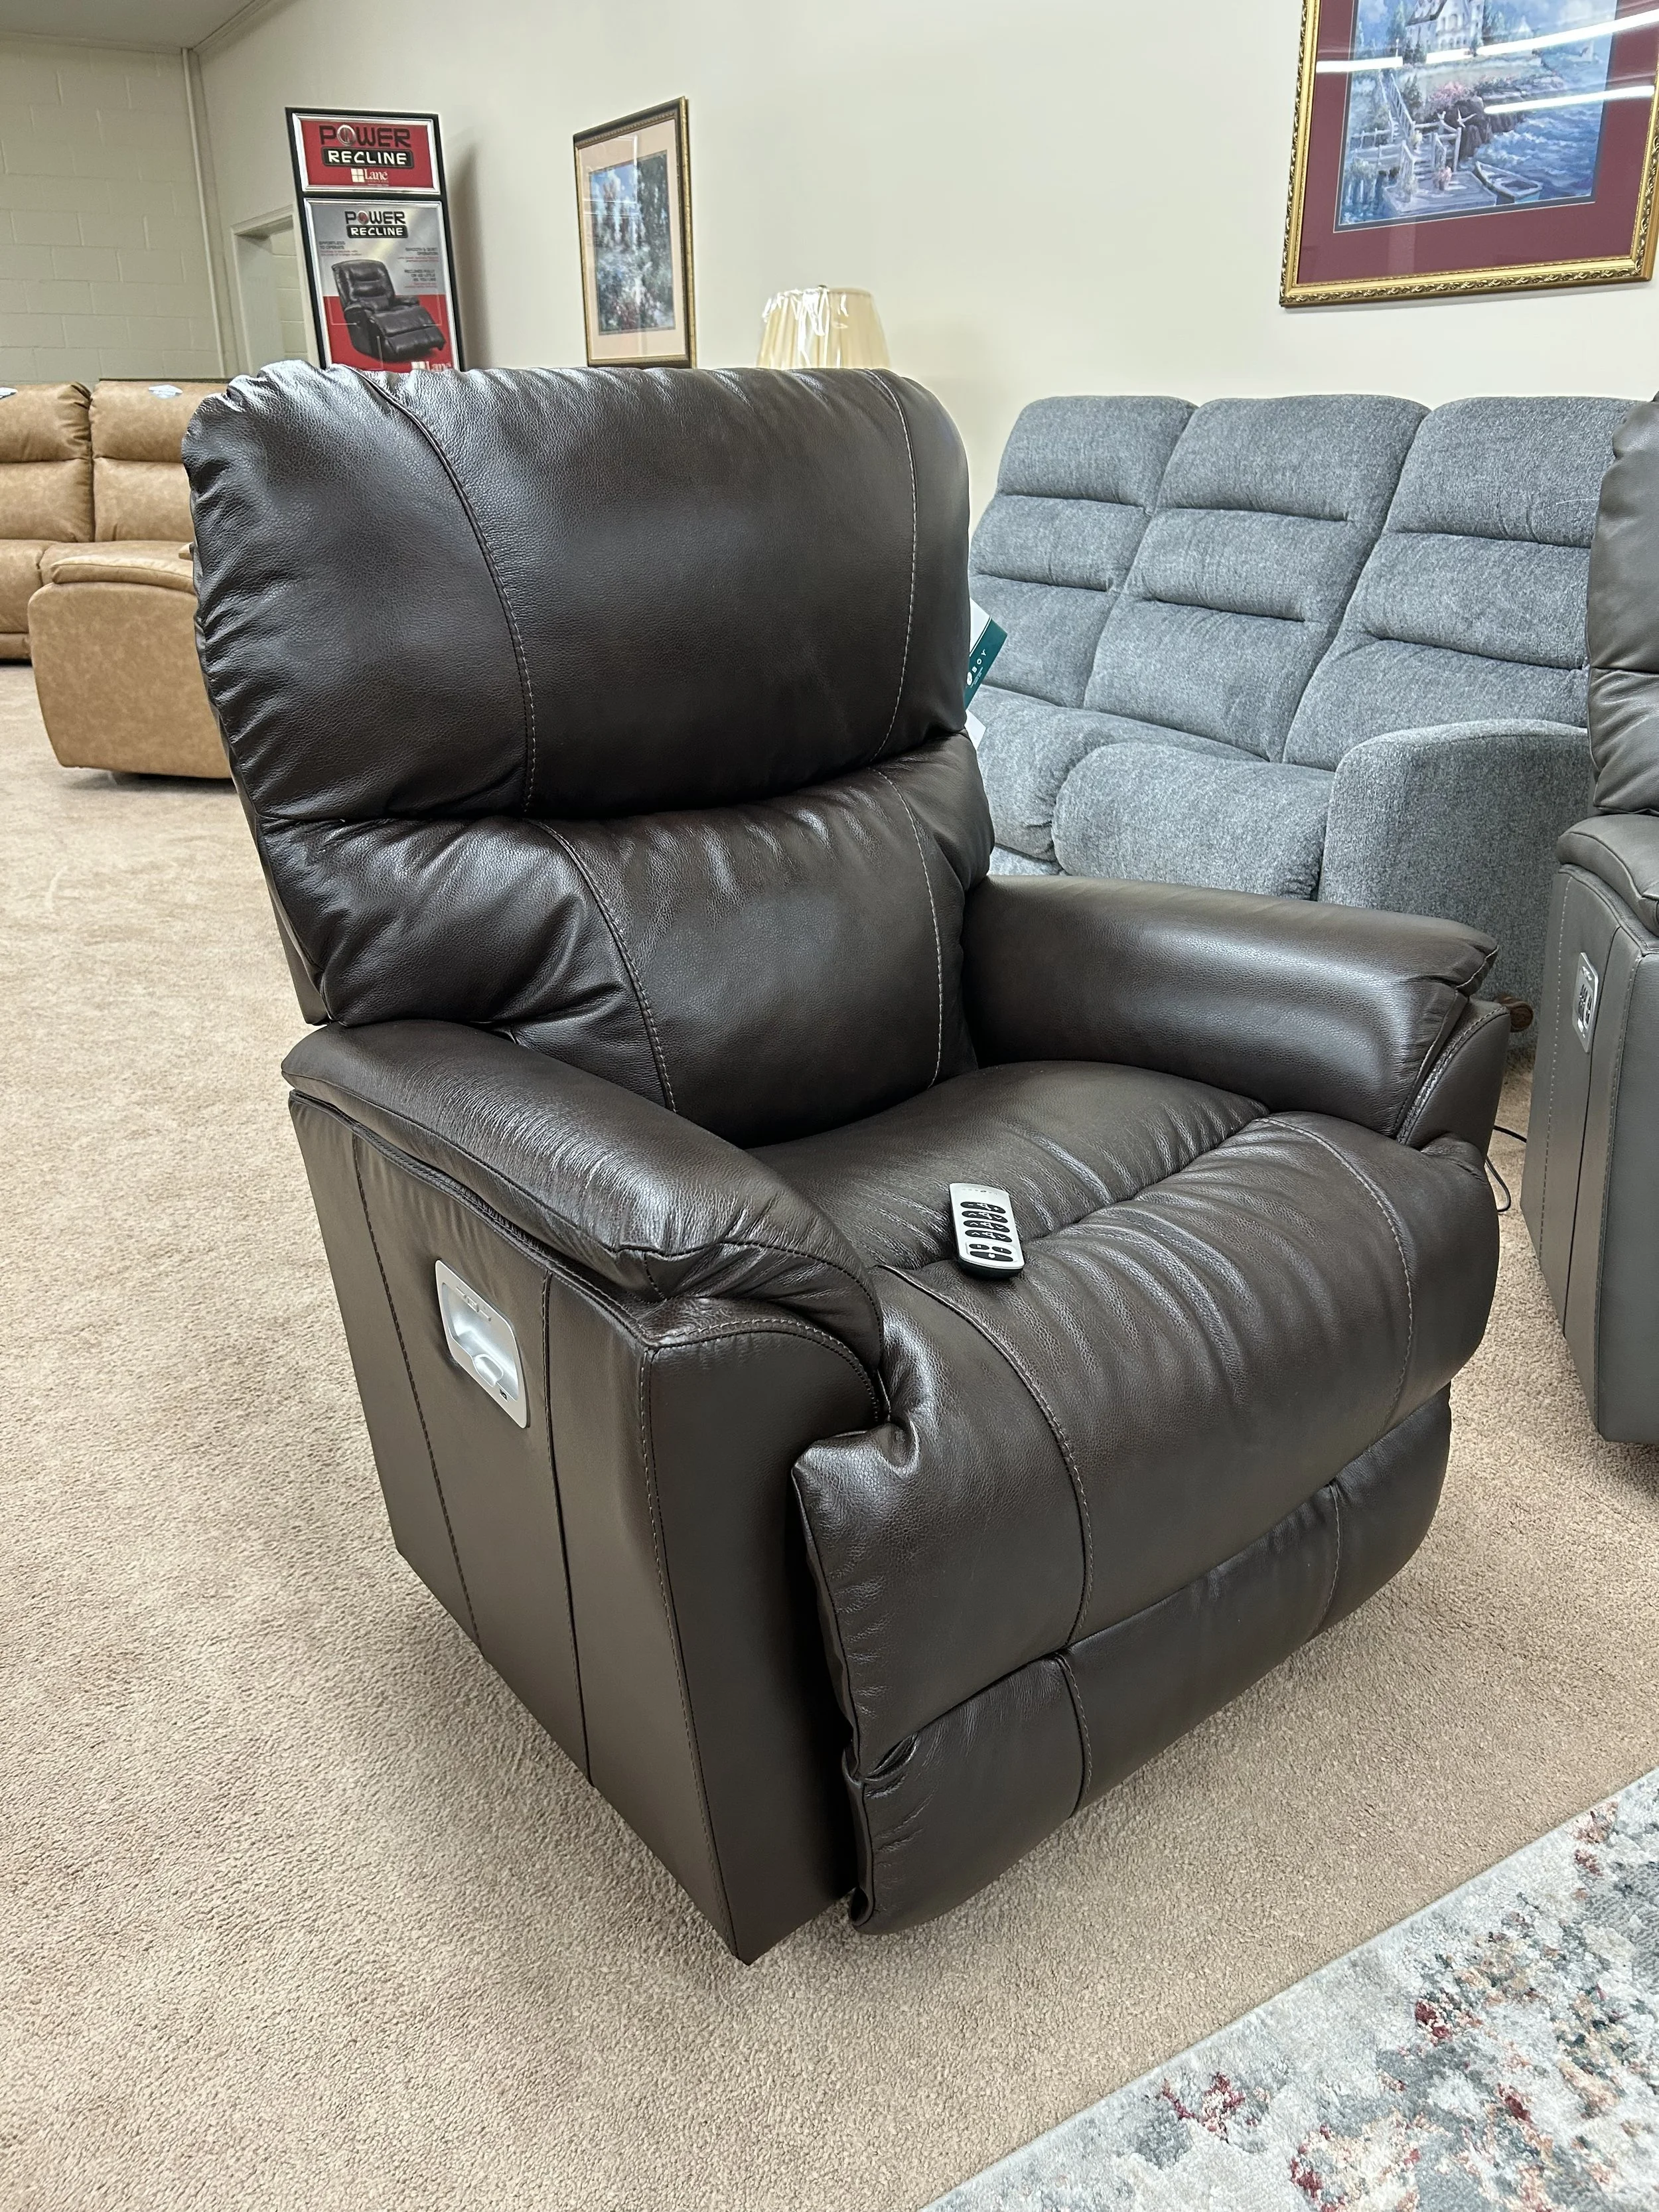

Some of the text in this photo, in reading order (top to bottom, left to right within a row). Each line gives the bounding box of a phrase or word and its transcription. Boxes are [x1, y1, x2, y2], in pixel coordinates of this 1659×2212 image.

[319, 124, 411, 147] POWER
[327, 150, 407, 165] RECLINE
[364, 168, 388, 181] Lane
[344, 210, 406, 225] POWER
[350, 227, 403, 236] RECLINE
